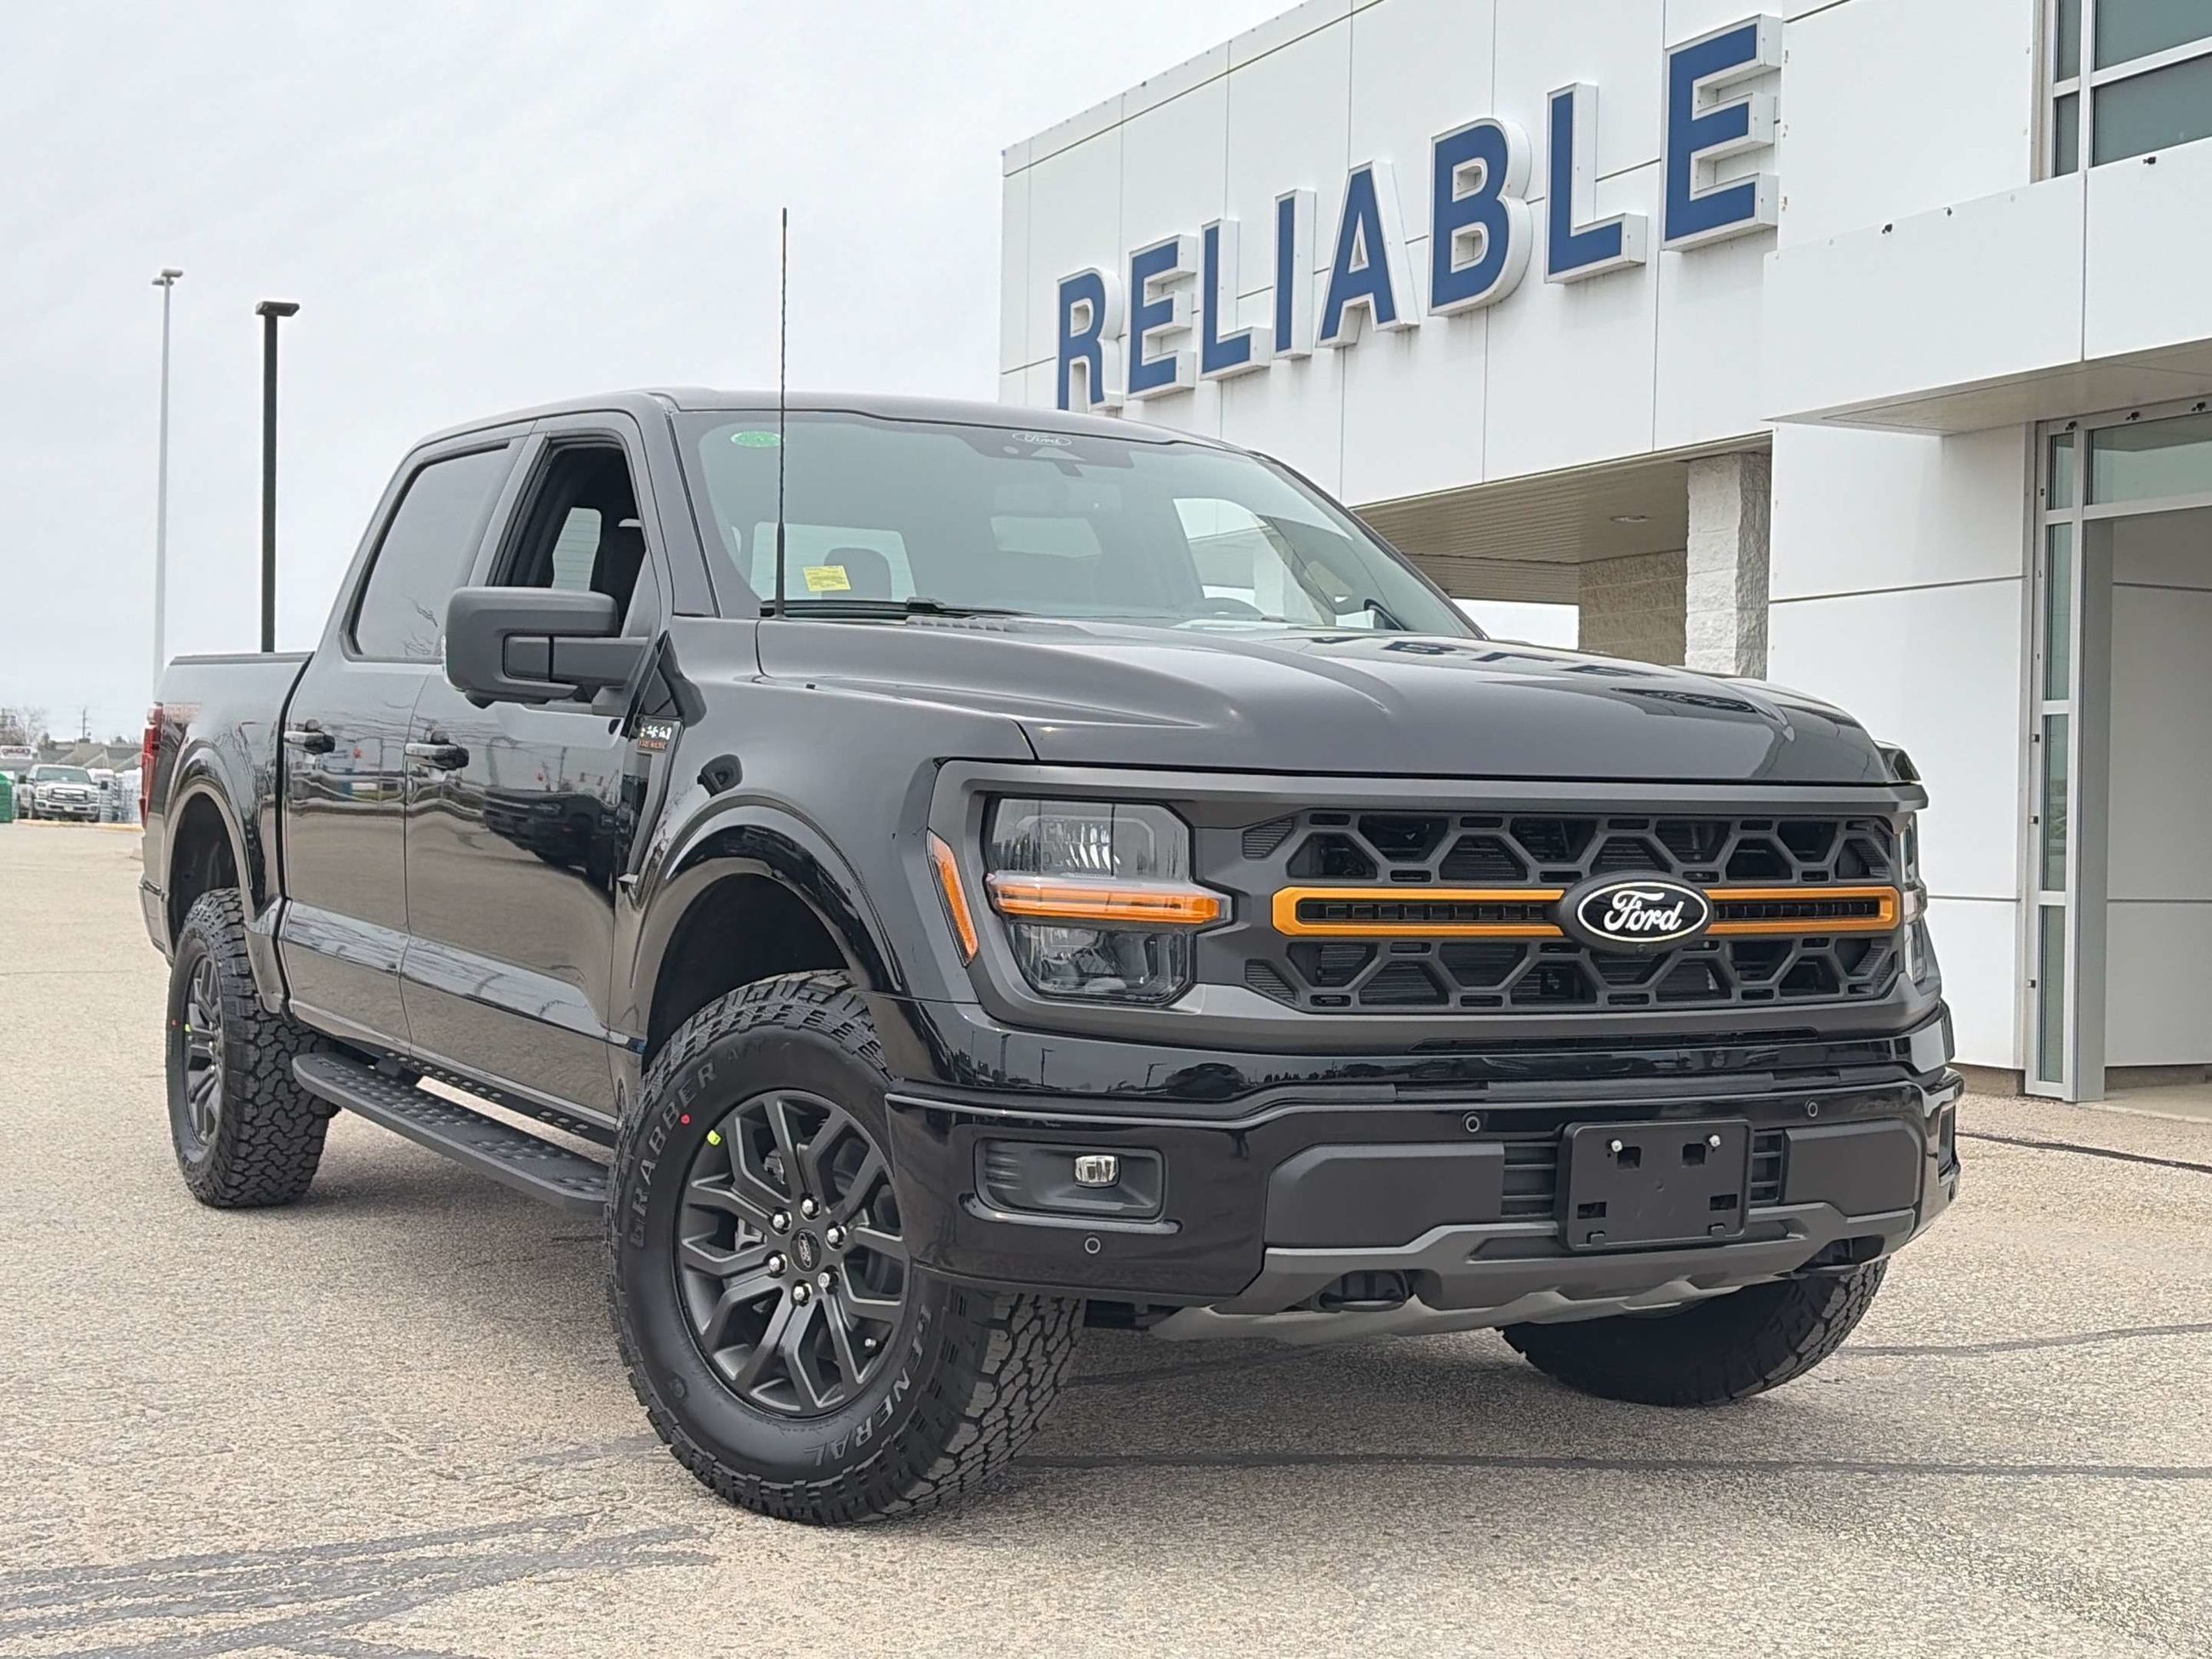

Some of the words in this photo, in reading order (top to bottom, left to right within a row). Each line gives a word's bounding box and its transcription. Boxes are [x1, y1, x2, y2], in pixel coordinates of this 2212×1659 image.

[1056, 15, 1780, 412] RELIABLE
[1604, 891, 1685, 931] Ford
[629, 1062, 716, 1248] GRABBER
[804, 1304, 932, 1466] GENERAL
